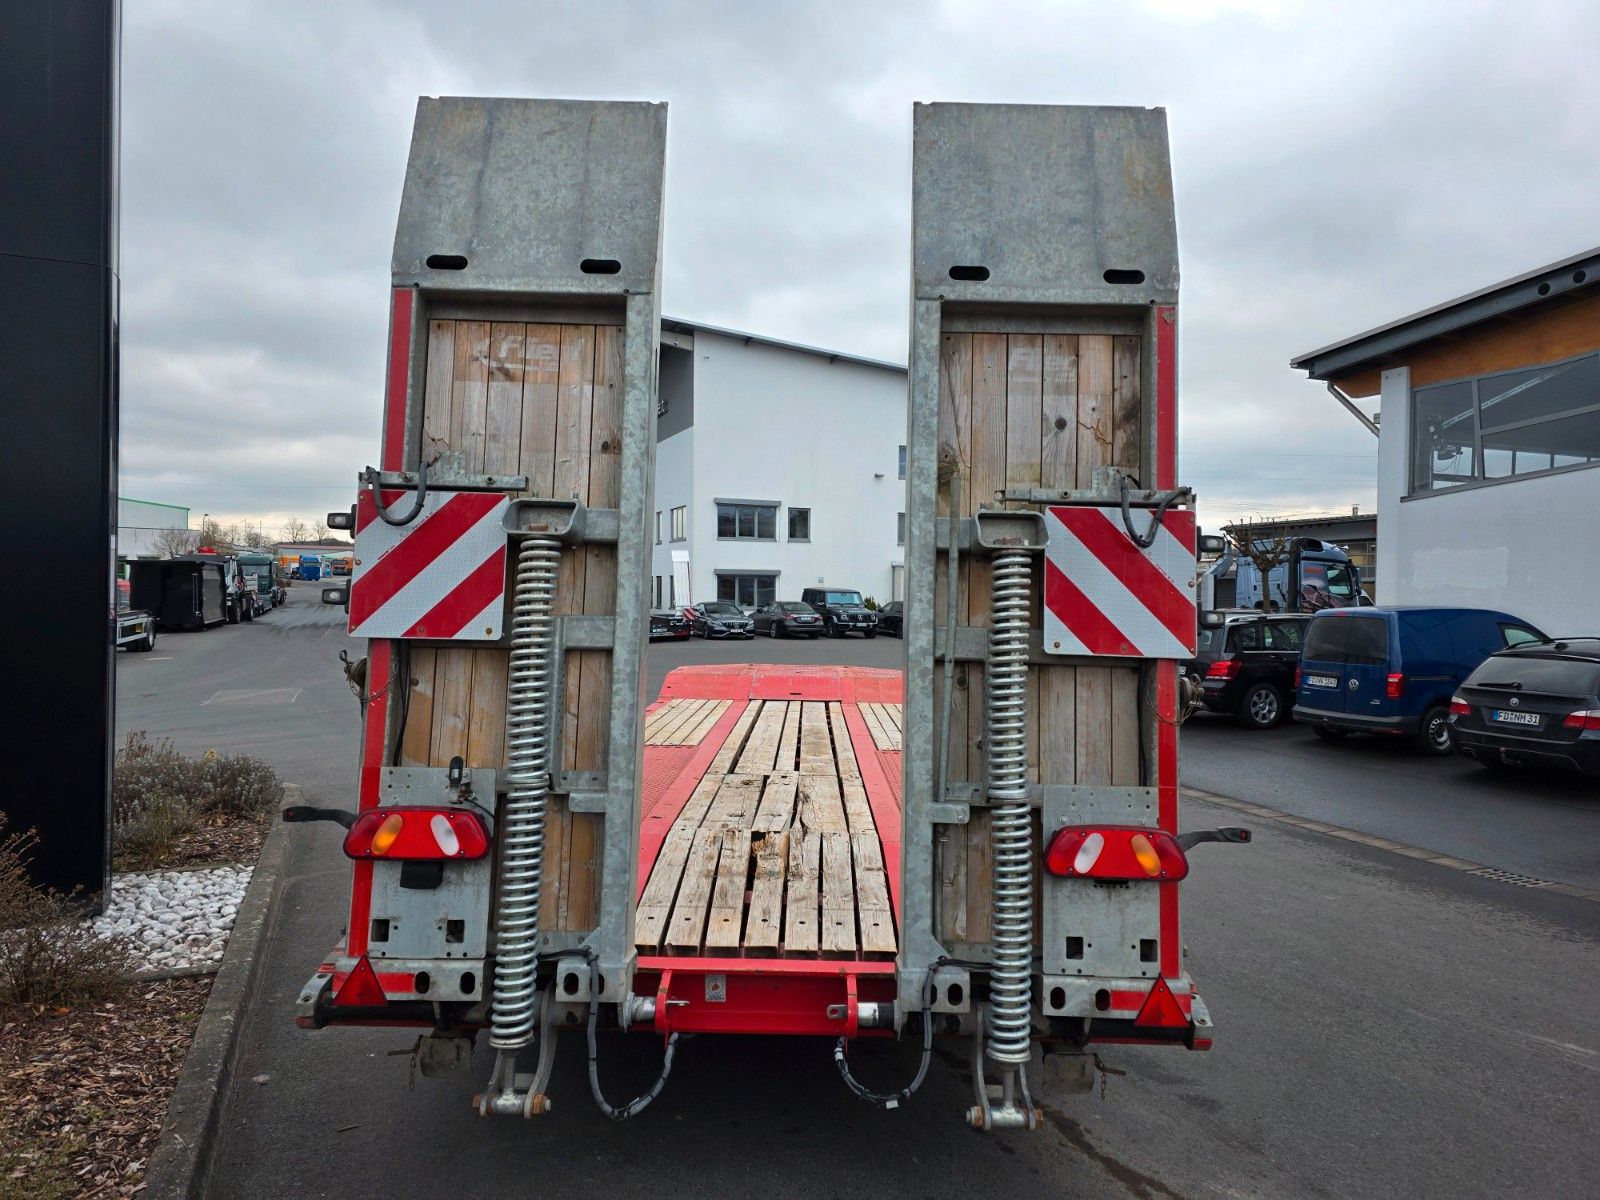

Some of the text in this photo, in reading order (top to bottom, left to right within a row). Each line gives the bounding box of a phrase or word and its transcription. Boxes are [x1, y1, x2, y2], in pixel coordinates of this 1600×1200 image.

[1499, 711, 1539, 724] FD NM 31
